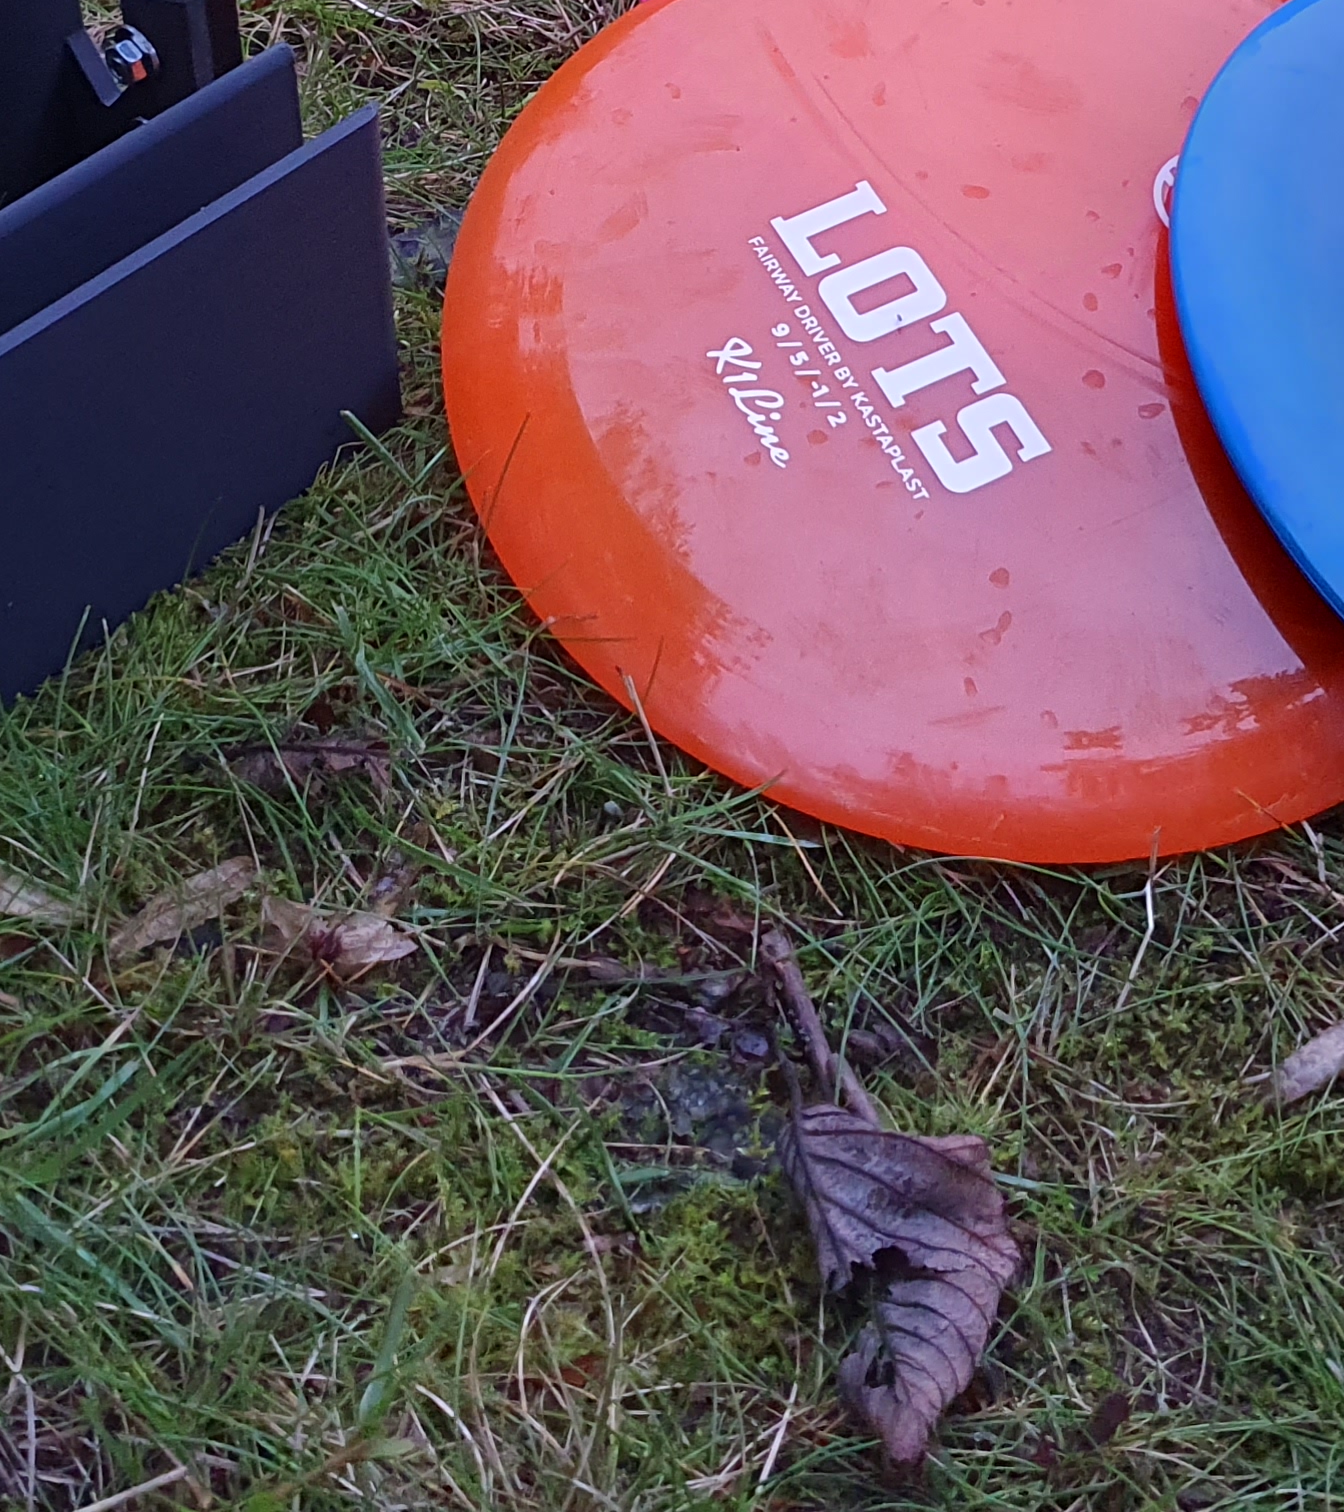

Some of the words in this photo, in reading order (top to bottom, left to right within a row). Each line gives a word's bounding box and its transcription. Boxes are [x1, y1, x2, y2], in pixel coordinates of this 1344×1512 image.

[747, 235, 803, 303] FAIRWAY
[794, 304, 842, 367] DRIVER
[833, 365, 860, 389] BY
[850, 391, 931, 500] KASTAPLAST
[769, 179, 1053, 493] LOTS
